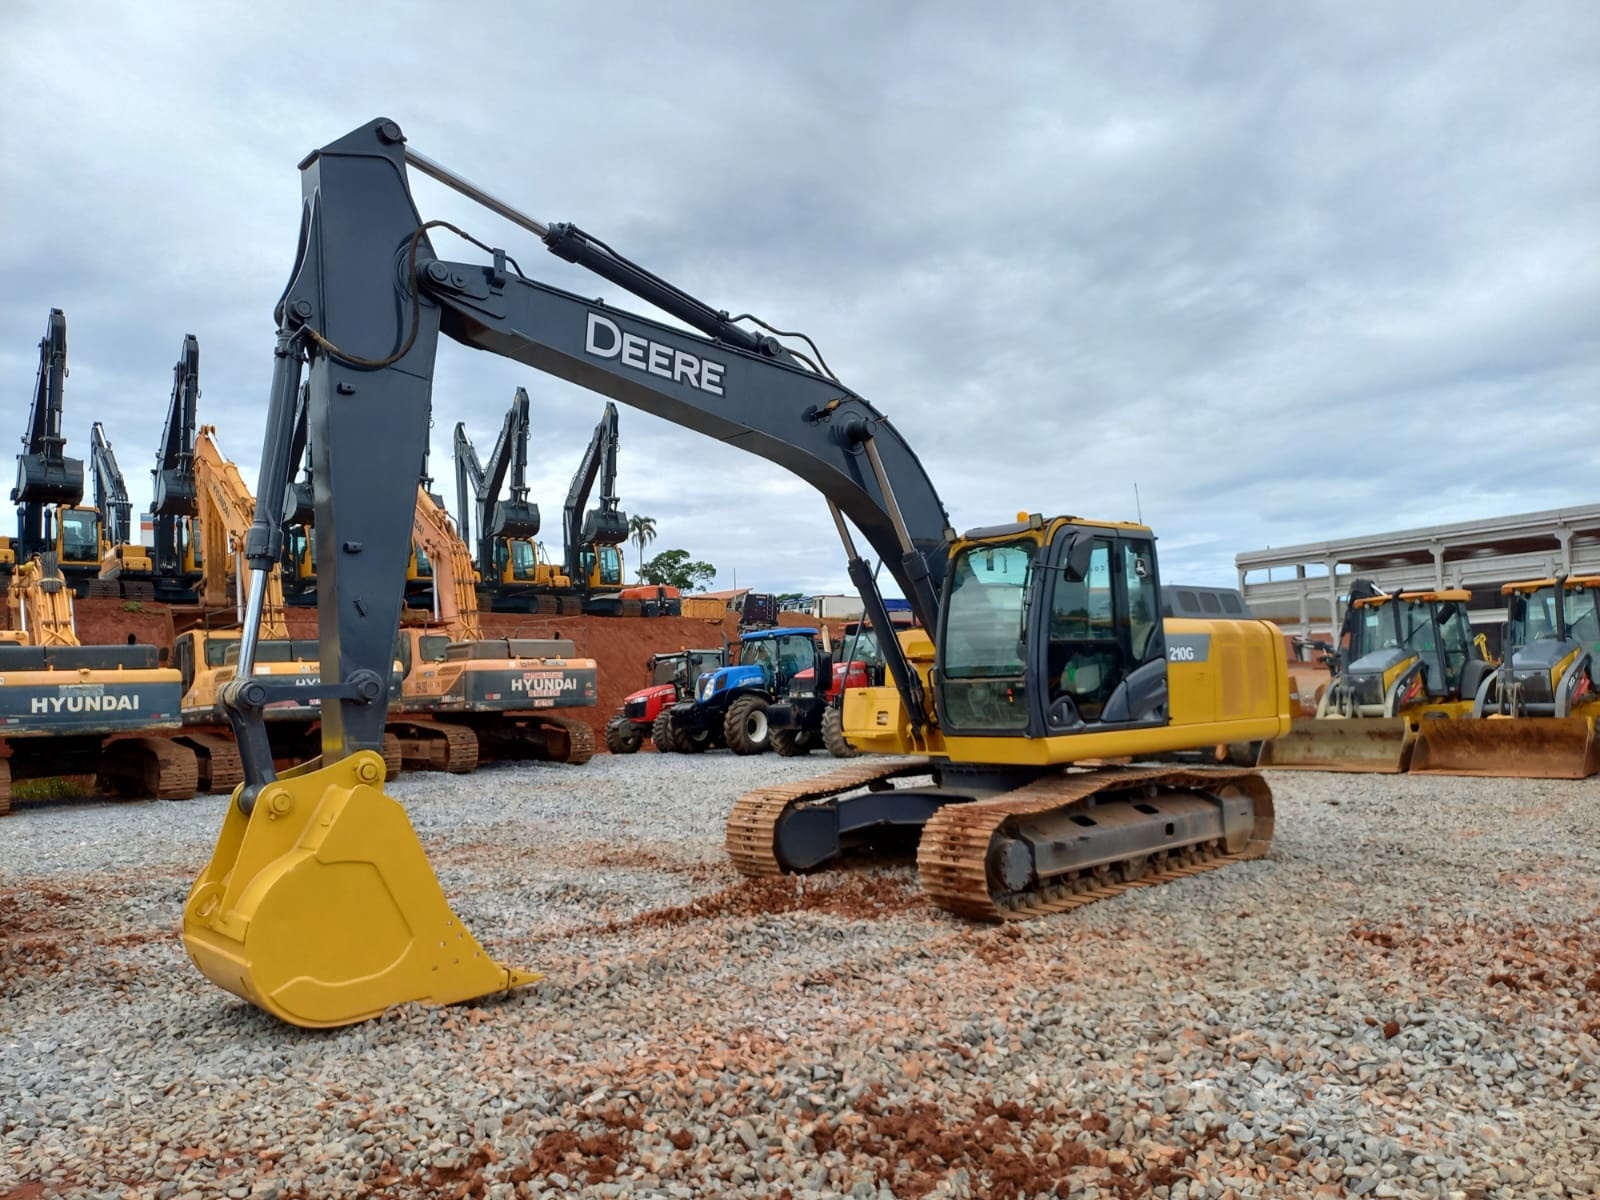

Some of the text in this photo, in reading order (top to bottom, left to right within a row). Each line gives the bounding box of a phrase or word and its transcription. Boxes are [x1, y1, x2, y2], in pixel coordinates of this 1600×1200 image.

[585, 312, 726, 396] DEERE
[1169, 646, 1195, 661] 210G
[511, 678, 577, 691] HYUNDAI
[31, 694, 140, 714] HYUNDAI
